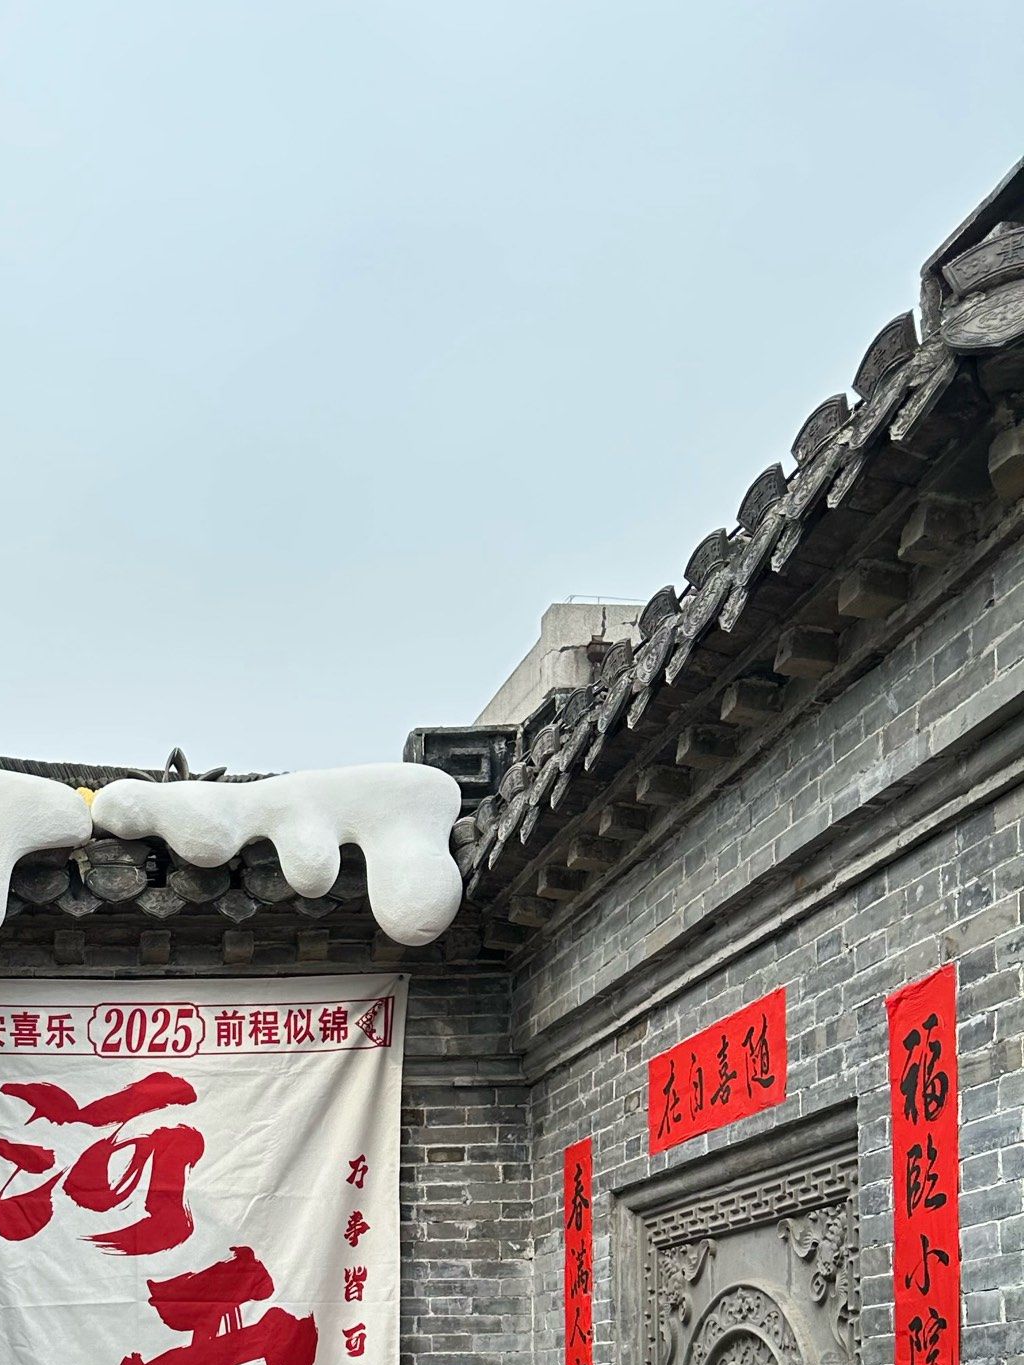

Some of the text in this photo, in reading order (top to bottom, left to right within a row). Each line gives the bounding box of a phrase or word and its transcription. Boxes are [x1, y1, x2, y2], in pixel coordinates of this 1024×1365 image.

[101, 1006, 194, 1054] 2025
[215, 1005, 349, 1047] 前程似锦
